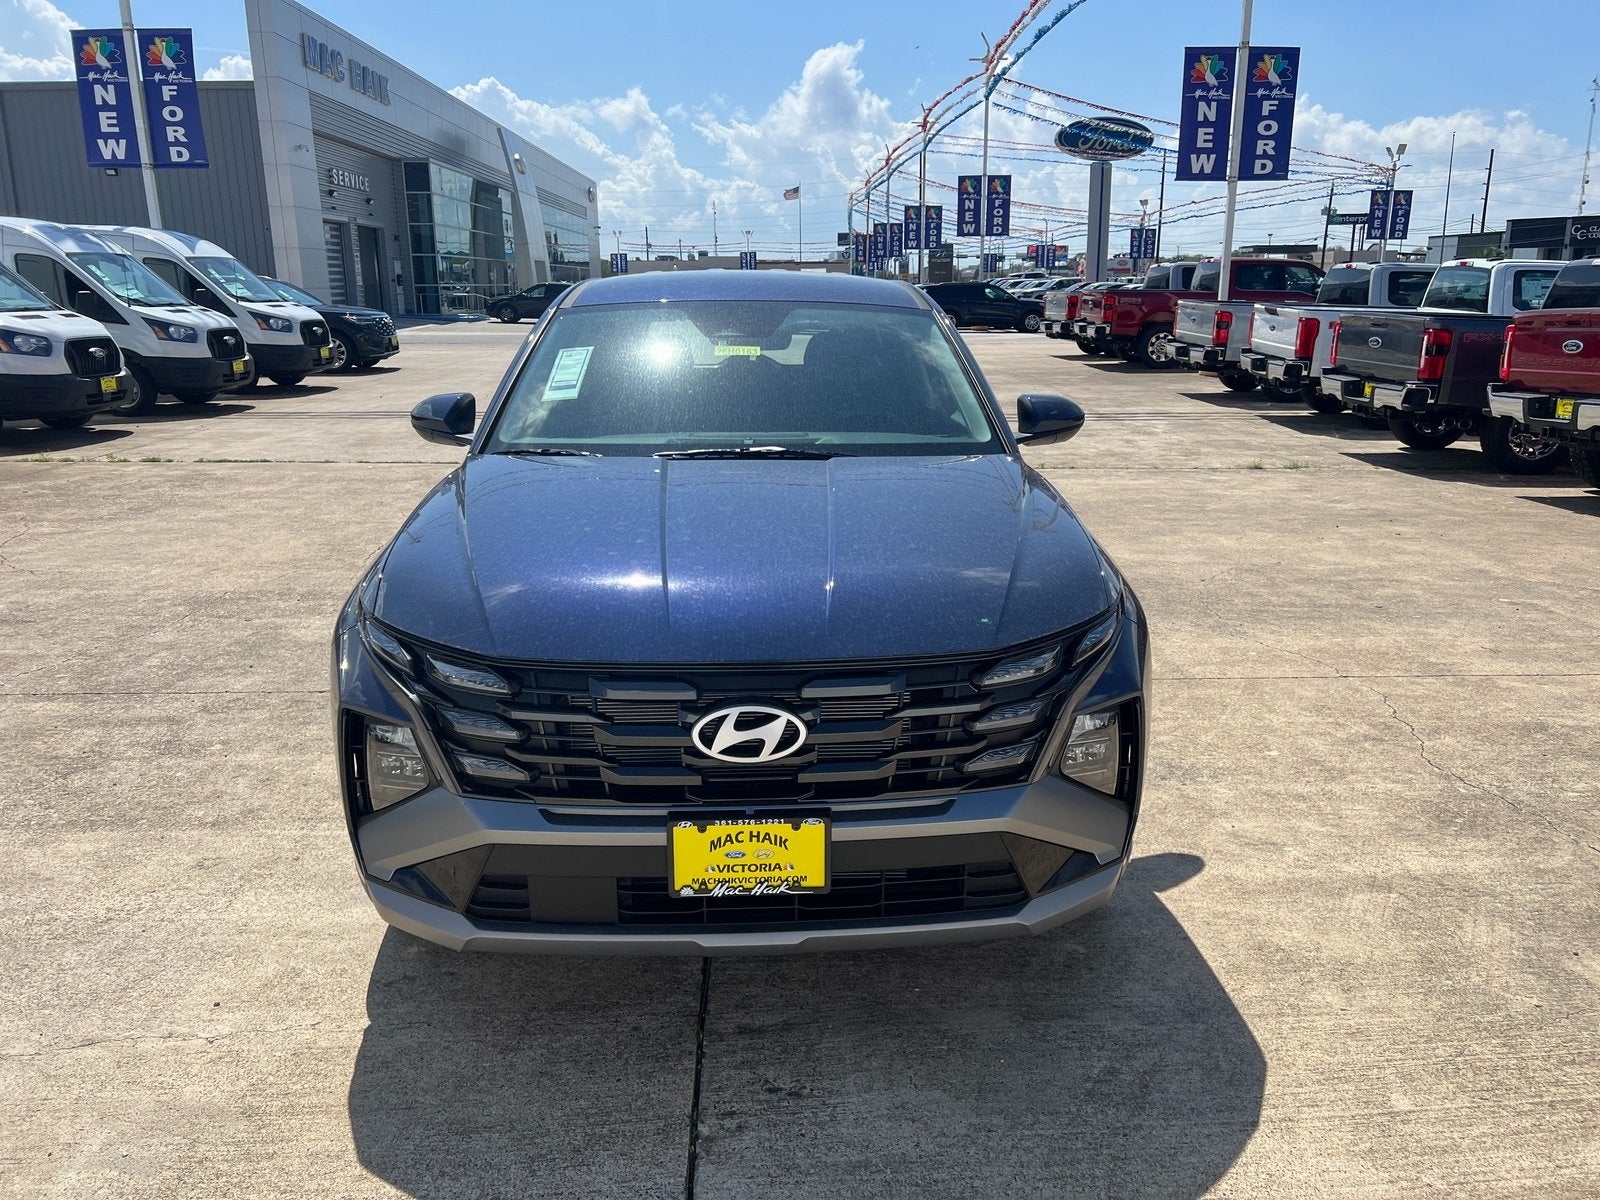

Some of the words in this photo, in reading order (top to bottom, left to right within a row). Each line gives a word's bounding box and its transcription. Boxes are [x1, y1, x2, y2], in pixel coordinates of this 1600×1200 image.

[305, 33, 345, 83] MAC
[349, 59, 391, 106] HAIK
[93, 84, 126, 160] NEW
[161, 85, 190, 162] FORD
[1078, 126, 1135, 150] Ford
[1190, 101, 1217, 174] NEW
[1253, 100, 1278, 175] FORD
[331, 168, 370, 192] SERVICE
[963, 199, 976, 234] NEW
[993, 199, 1003, 234] FORD
[1371, 209, 1383, 238] NEW
[1394, 209, 1405, 238] FORD
[877, 236, 885, 256] NEW
[908, 222, 917, 248] NEW
[929, 222, 937, 248] FORD
[1132, 240, 1140, 258] NEW
[714, 818, 784, 826] 361-576-1221
[709, 830, 745, 853] MAC
[749, 830, 789, 851] HAIK
[691, 875, 808, 886] MACHAIKVICTORIA.COM
[716, 862, 783, 874] VICTORIA
[710, 882, 745, 897] Mac
[751, 881, 793, 896] Haik
